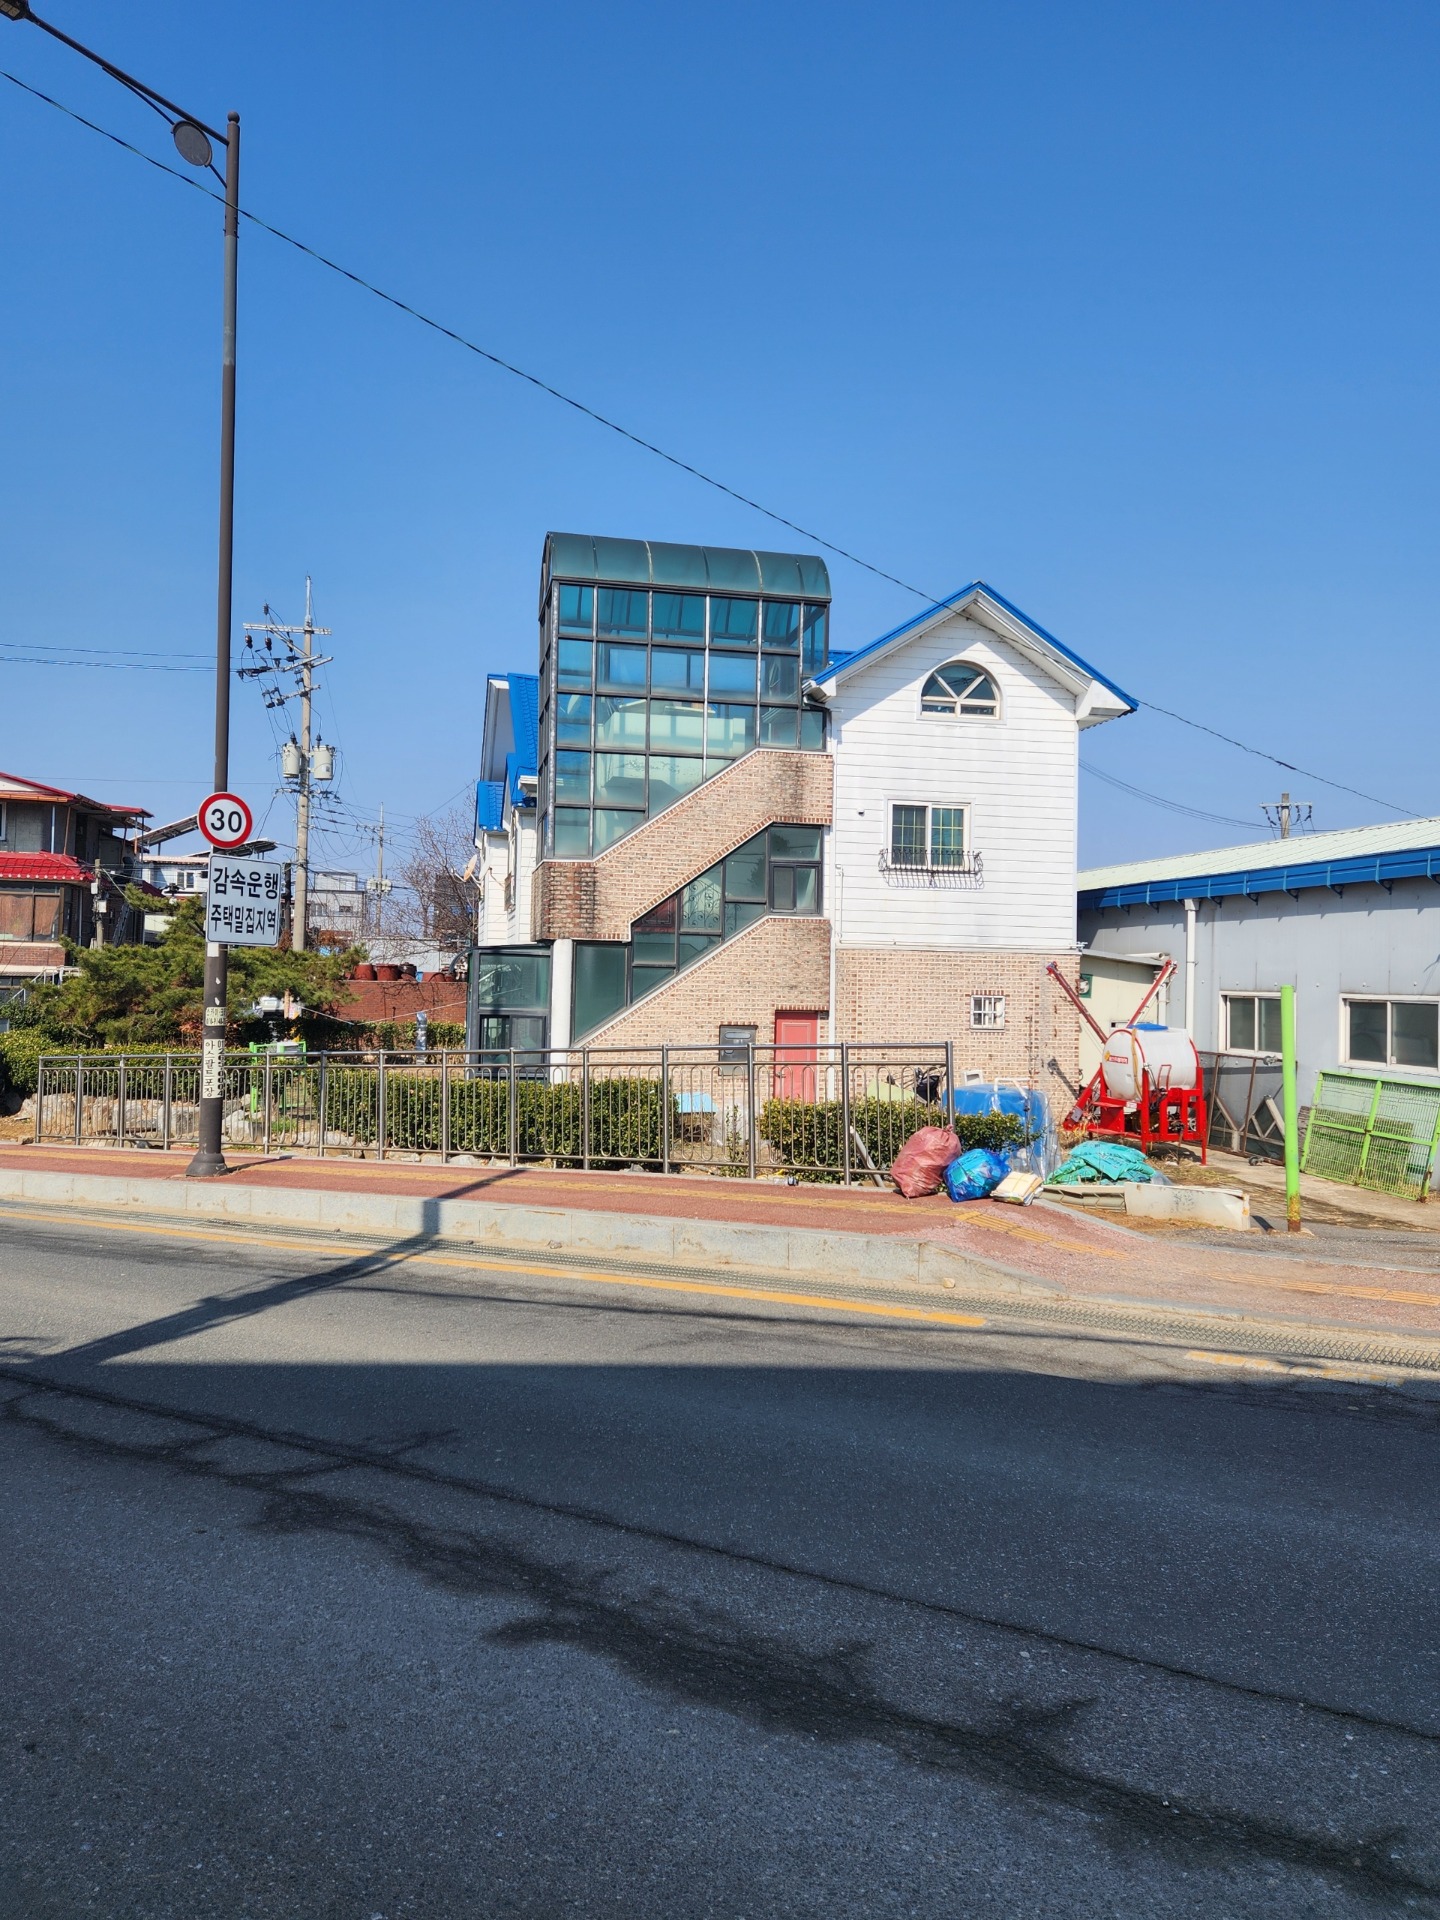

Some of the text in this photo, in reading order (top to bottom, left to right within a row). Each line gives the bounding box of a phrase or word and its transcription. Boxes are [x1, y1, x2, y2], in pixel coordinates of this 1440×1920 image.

[210, 808, 242, 833] 30
[213, 866, 279, 900] 감속운행
[210, 903, 277, 937] 주택밀집지역
